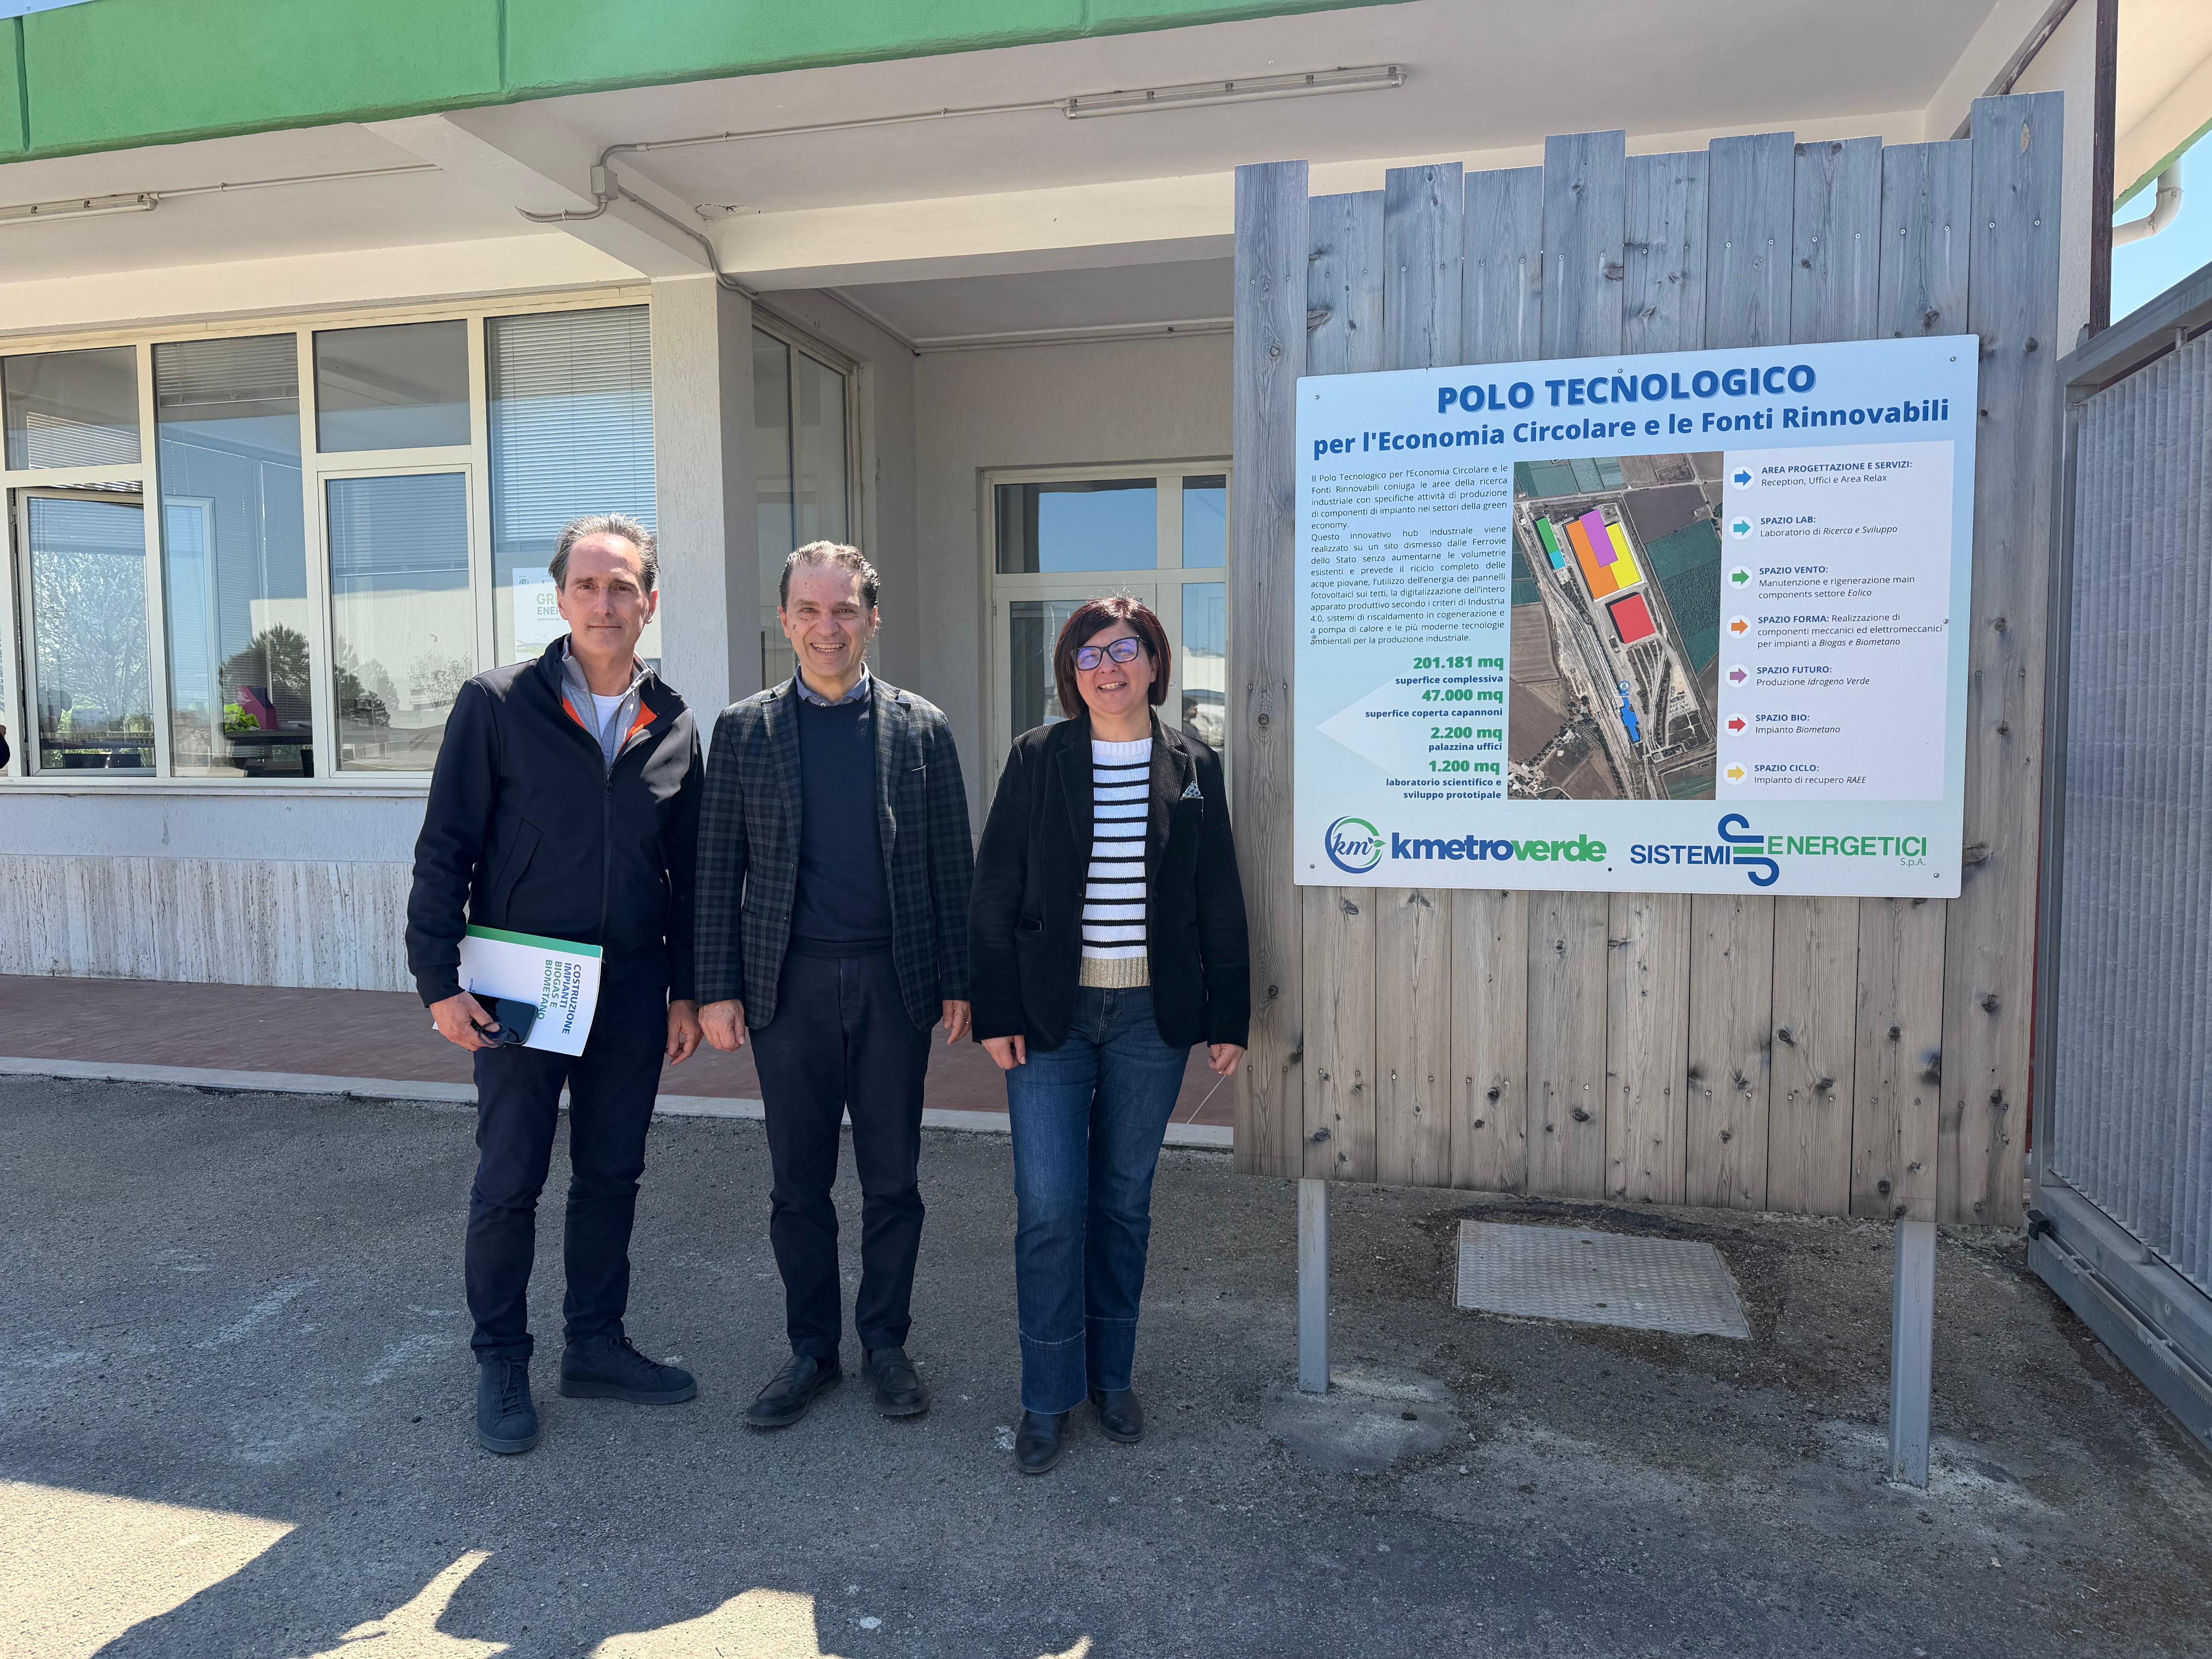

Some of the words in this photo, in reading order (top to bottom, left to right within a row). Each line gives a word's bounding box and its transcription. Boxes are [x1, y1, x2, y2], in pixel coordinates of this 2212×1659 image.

[1438, 381, 1535, 415] POLO
[1545, 365, 1817, 407] TECNOLOGICO
[1314, 438, 1356, 461] per
[1513, 418, 1636, 443] Circolare
[1644, 420, 1660, 435] e
[1669, 413, 1693, 434] le
[1702, 407, 1773, 432] Fonti
[1783, 398, 1948, 429] Rinnovabili
[1339, 472, 1386, 481] Tecnologico
[1389, 472, 1403, 480] per
[1452, 466, 1489, 474] Circolare
[1788, 462, 1865, 473] PROGETTAZIONE
[1875, 461, 1912, 469] SERVIZI:
[1312, 486, 1331, 494] Fonti
[1336, 483, 1379, 493] Rinnovabili
[1384, 482, 1415, 491] coniuga
[1455, 478, 1475, 486] della
[1761, 478, 1806, 488] Reception,
[1809, 476, 1831, 484] Uffici
[1864, 474, 1887, 482] Relax
[1312, 497, 1353, 505] industriale
[1374, 494, 1414, 505] specifiche
[1417, 492, 1445, 500] attività
[1460, 489, 1507, 500] produzione
[1321, 508, 1368, 518] componenti
[1380, 507, 1415, 516] impianto
[1433, 503, 1459, 512] settori
[1461, 502, 1481, 510] della
[1483, 502, 1507, 511] green
[1760, 517, 1793, 525] SPAZIO
[1311, 534, 1339, 542] Questo
[1351, 531, 1391, 540] innovativo
[1430, 527, 1473, 536] industriale
[1862, 525, 1897, 535] Sviluppo
[1447, 539, 1467, 547] dalle
[1473, 537, 1506, 546] Ferrovie
[1461, 549, 1506, 558] volumetrie
[1794, 566, 1828, 574] VENTO:
[1759, 578, 1821, 587] Manutenzione
[1831, 576, 1890, 587] rigenerazione
[1758, 591, 1812, 601] components
[1847, 588, 1872, 597] Eolico
[1758, 616, 1791, 624] SPAZIO
[1832, 614, 1890, 622] Realizzazione
[1758, 627, 1809, 637] componenti
[1812, 626, 1854, 635] meccanici
[1870, 624, 1942, 633] elettromeccanici
[1378, 636, 1424, 645] produzione
[1426, 634, 1471, 642] industriale.
[1758, 642, 1772, 650] per
[1774, 639, 1809, 649] impianti
[1819, 639, 1846, 648] Biogas
[1413, 656, 1472, 669] 201.181
[1478, 658, 1504, 671] mq
[1395, 676, 1440, 686] superfice
[1443, 674, 1503, 685] complessiva
[1757, 678, 1805, 686] Produzione
[1807, 677, 1844, 687] Idrogeno
[1421, 689, 1473, 702] 47.000
[1477, 691, 1503, 704] mq
[1365, 709, 1409, 719] superfice
[1411, 709, 1449, 719] coperta
[1451, 708, 1503, 718] capannoni
[1430, 727, 1473, 739] 2.200
[1477, 728, 1503, 742] mq
[1756, 726, 1794, 735] Impianto
[1429, 743, 1474, 753] palazzina
[1477, 742, 1502, 750] uffici
[1428, 760, 1470, 772] 1.200
[1474, 762, 1500, 775] mq
[1443, 778, 1493, 786] scientifico
[1754, 776, 1792, 785] Impianto
[1403, 791, 1444, 801] sviluppo
[1446, 791, 1501, 801] prototipale
[1333, 833, 1373, 855] km
[1392, 832, 1607, 862] kmetroverde
[1630, 844, 1730, 865] SISTEMI
[1768, 836, 1927, 857] ENERGETICI
[1900, 858, 1926, 868] S.p.A.
[551, 961, 563, 999] BIOGAS
[559, 963, 572, 1008] IMPIANTI
[537, 960, 553, 1020] BIOMETANO
[562, 964, 581, 1035] COSTRUZIONE
